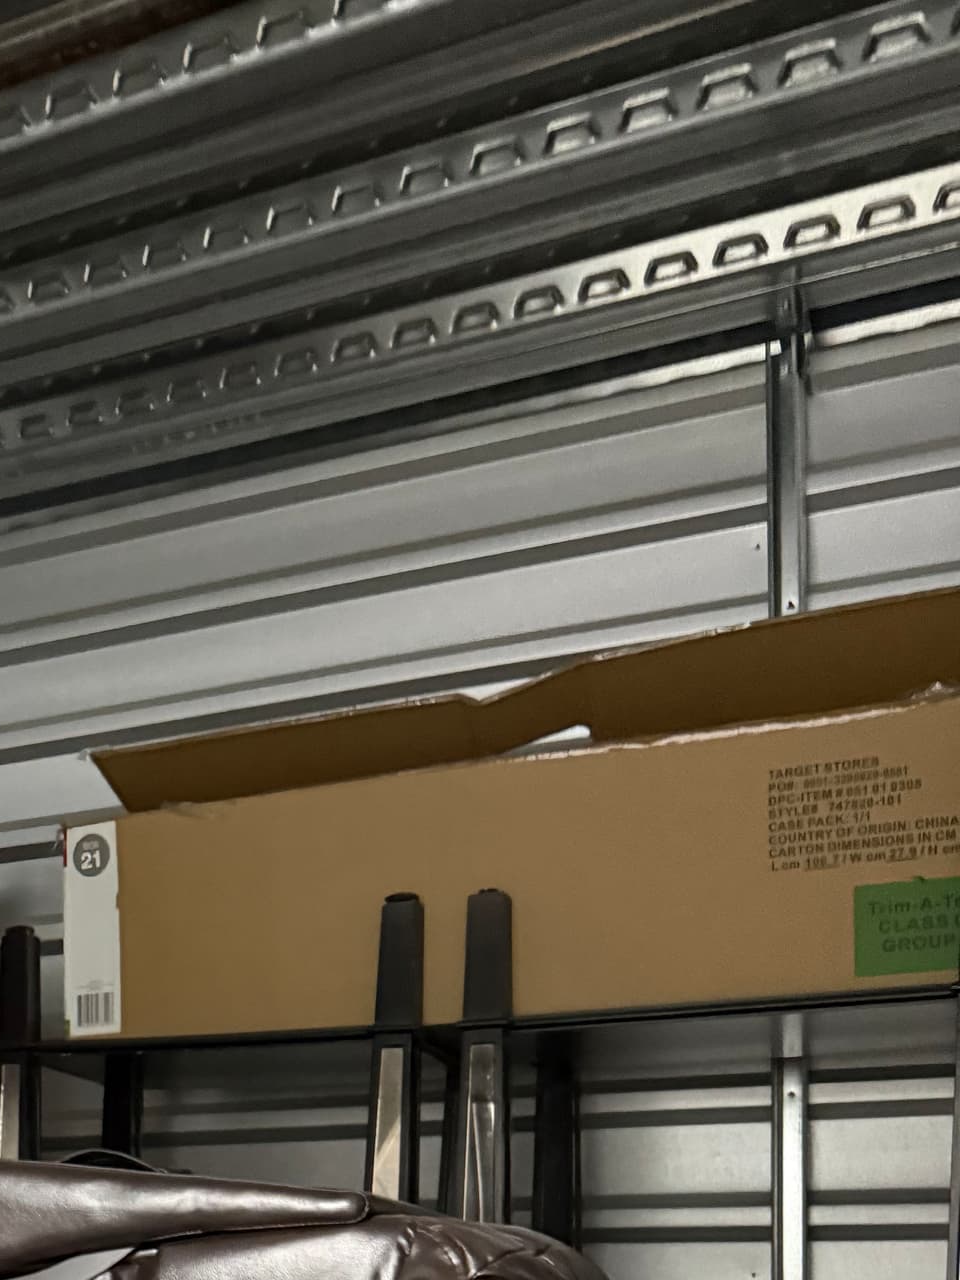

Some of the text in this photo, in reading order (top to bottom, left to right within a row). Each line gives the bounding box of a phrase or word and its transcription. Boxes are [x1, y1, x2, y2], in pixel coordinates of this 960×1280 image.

[768, 757, 880, 780] TARGET STORES
[768, 818, 804, 833] CASE
[768, 829, 833, 845] COUNTRY
[836, 827, 854, 839] OF
[915, 815, 960, 831] CHINA
[768, 829, 957, 859] CARTON DIMENSIONS IN CM
[80, 849, 101, 871] 21
[881, 933, 957, 953] GROUP
